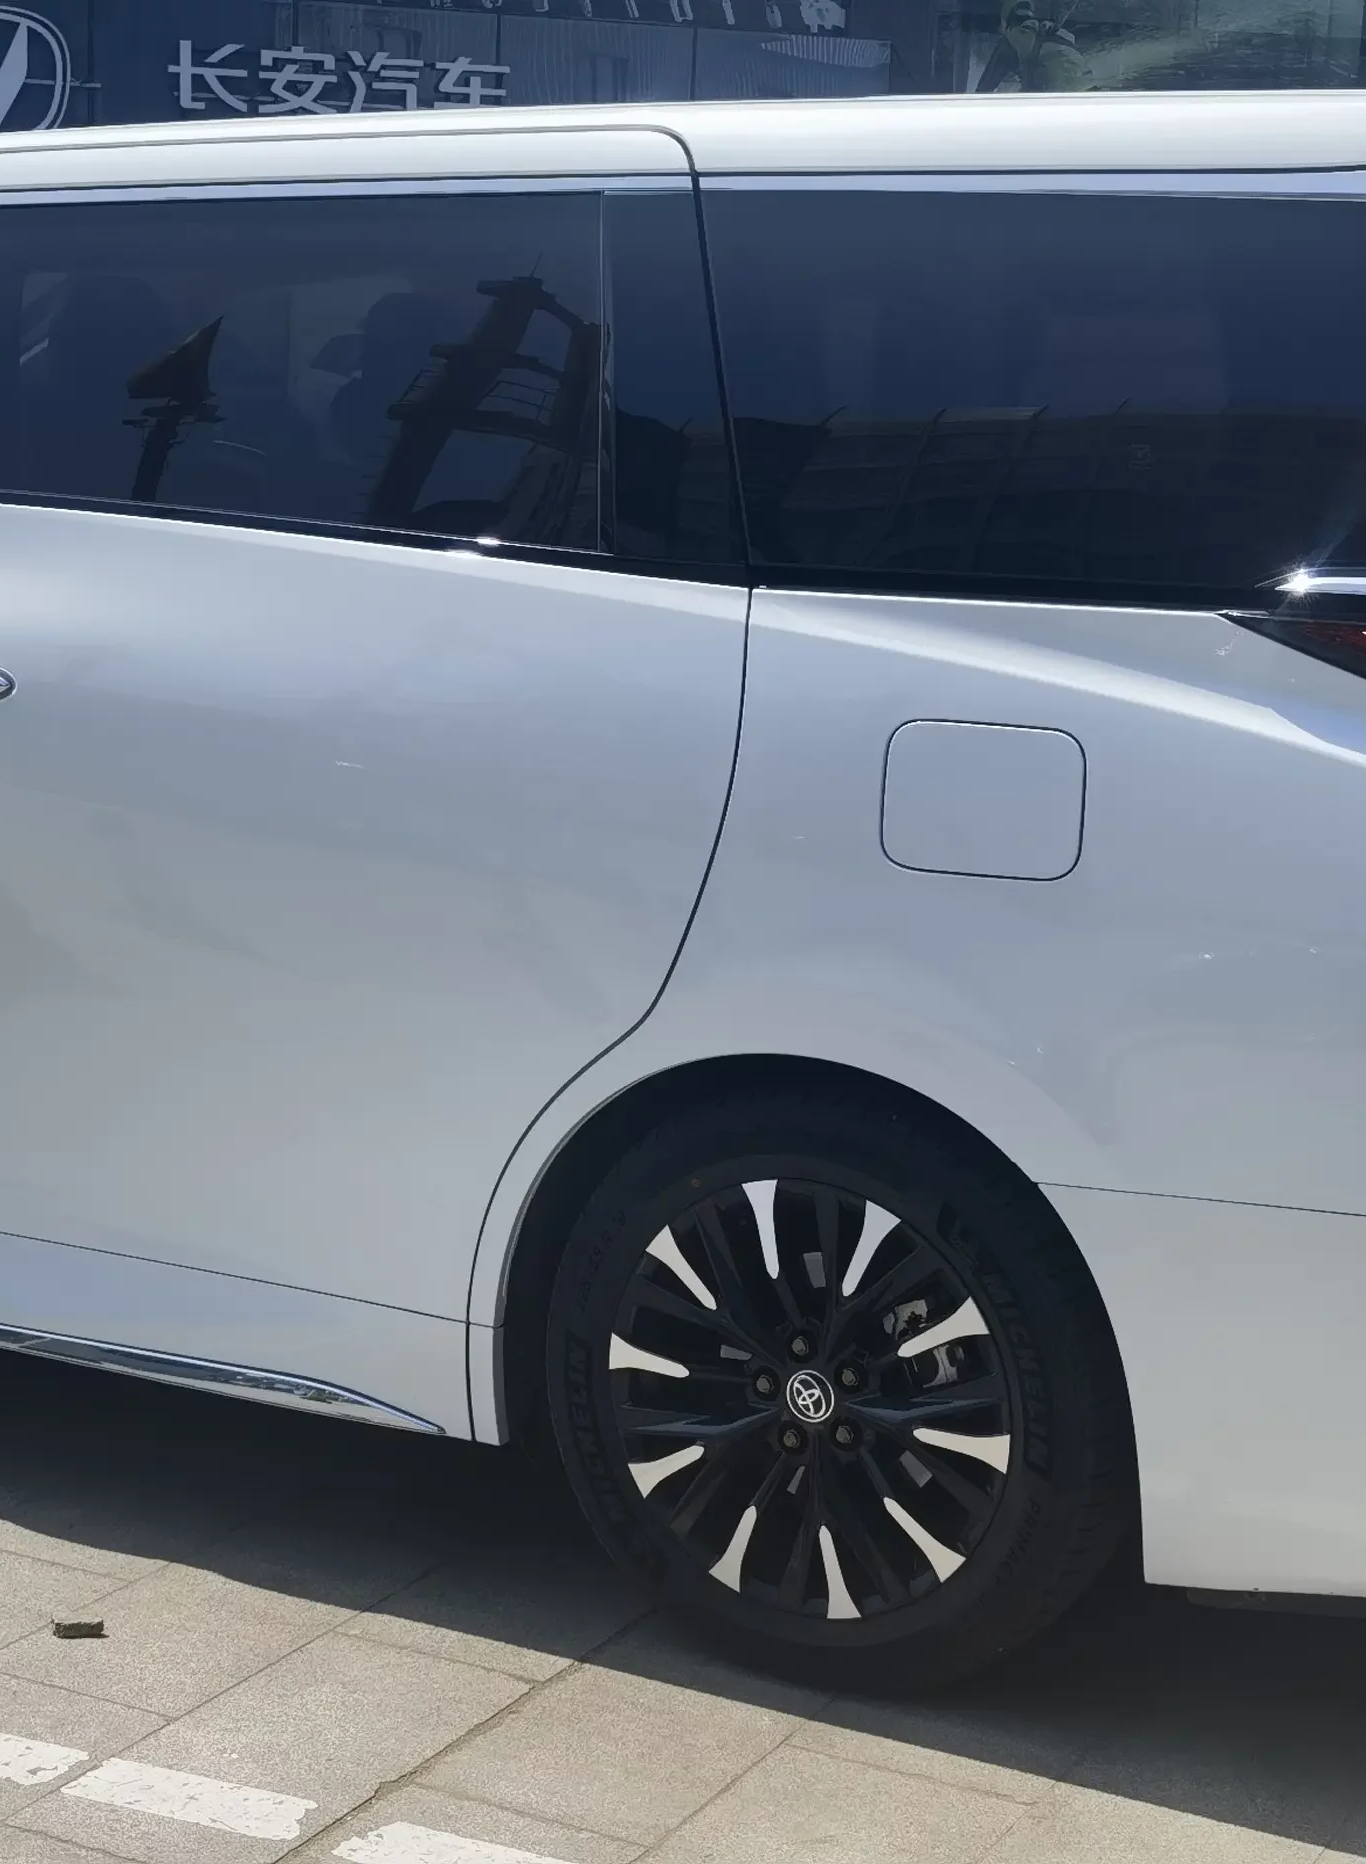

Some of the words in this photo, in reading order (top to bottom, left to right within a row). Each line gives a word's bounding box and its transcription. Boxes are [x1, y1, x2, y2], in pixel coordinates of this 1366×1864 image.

[168, 40, 511, 113] 长安汽车
[980, 1272, 1049, 1471] MICHELIN
